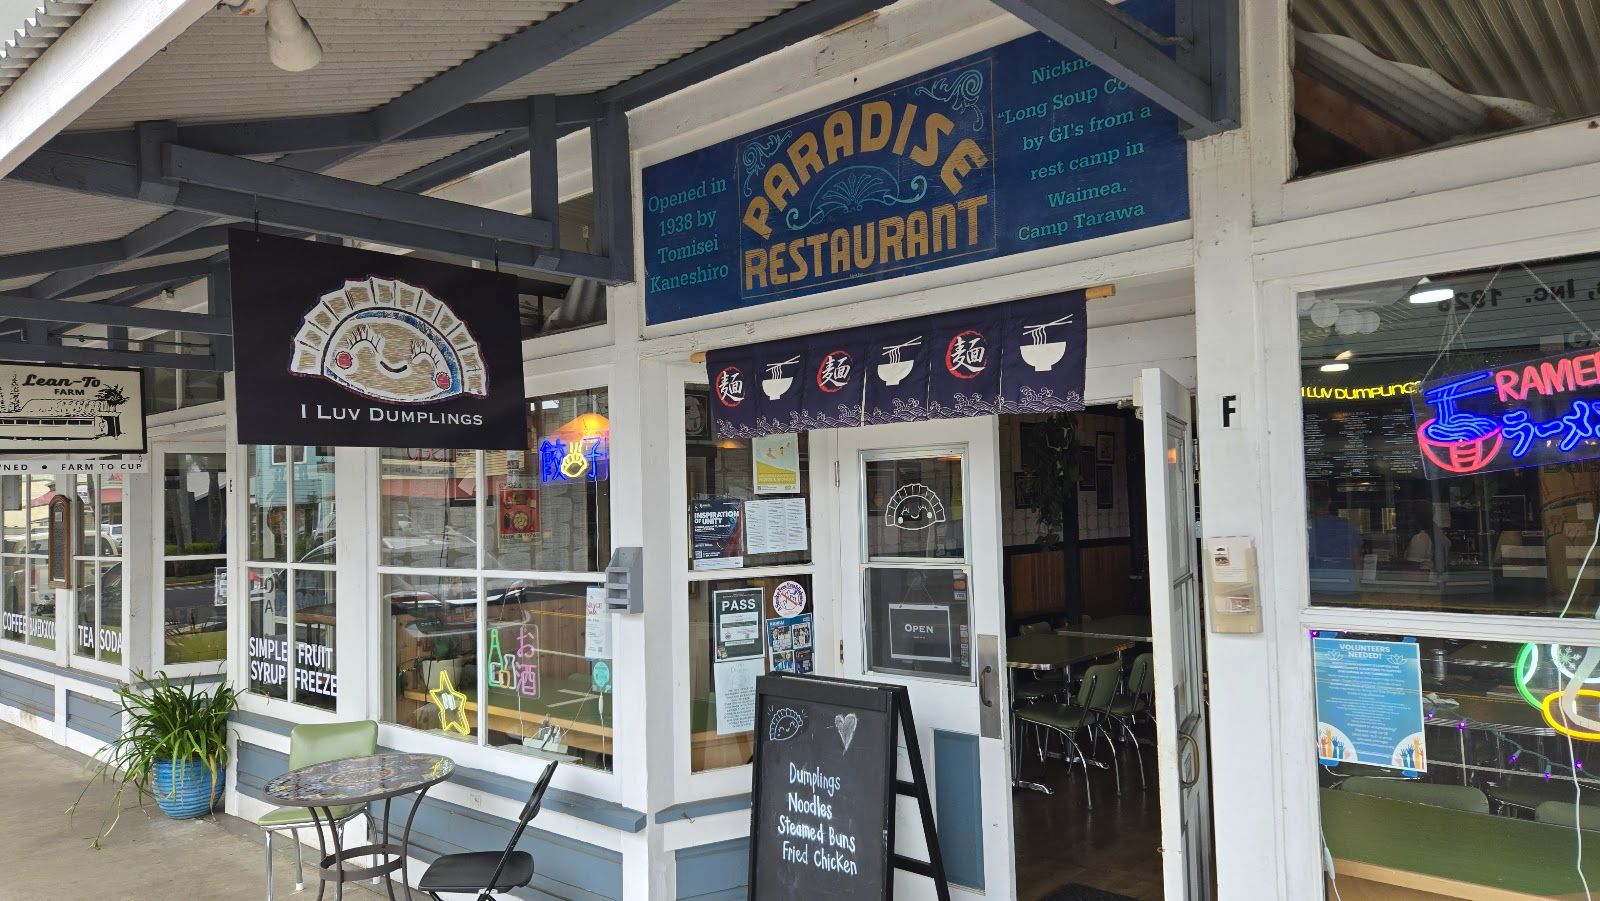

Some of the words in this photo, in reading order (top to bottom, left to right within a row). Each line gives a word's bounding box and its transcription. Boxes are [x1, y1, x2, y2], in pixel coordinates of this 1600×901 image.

[1031, 58, 1097, 85] Nickna
[1052, 87, 1098, 110] Soup
[1103, 77, 1132, 94] Co
[1022, 134, 1044, 151] by
[1088, 110, 1135, 132] from
[1140, 106, 1152, 118] a
[742, 100, 989, 240] PARADISE
[1030, 161, 1064, 181] rest
[1069, 147, 1120, 171] camp
[1125, 141, 1145, 157] in
[648, 182, 707, 213] Opened
[711, 178, 727, 195] in
[1047, 181, 1127, 208] Waimea.
[659, 213, 693, 237] 1938
[697, 210, 717, 228] by
[1018, 220, 1068, 241] Camp
[1073, 204, 1146, 229] Tarawa
[657, 234, 719, 265] Tomisei
[744, 194, 988, 290] RESTAURANT
[650, 264, 729, 293] Kaneshiro
[22, 374, 101, 388] Lean-To
[1495, 351, 1600, 402] RAME
[54, 388, 85, 396] FARM
[1306, 386, 1333, 399] LUV
[300, 404, 306, 419] I
[317, 404, 361, 422] LUV
[369, 406, 483, 426] DUMPLINGS
[1222, 395, 1237, 428] F
[0, 463, 28, 471] NED
[61, 463, 94, 471] FARM
[229, 479, 233, 493] E
[694, 510, 740, 519] INSPIRATION
[702, 517, 723, 525] UNITY
[721, 598, 756, 612] PASS
[78, 624, 95, 649] TEA
[99, 628, 122, 654] SODA
[904, 623, 934, 634] OPEN
[249, 636, 288, 662] SIMPLE
[298, 643, 334, 669] FRUIT
[516, 626, 536, 696] お酒
[1340, 643, 1391, 653] VOLUNTEERS
[1347, 651, 1382, 660] NEEDED!
[251, 661, 286, 685] SYRUP
[294, 668, 338, 697] FREEZE
[789, 762, 841, 797] Dumplings
[788, 792, 833, 820] Noodles
[777, 815, 824, 844] Steamed
[829, 828, 856, 854] Buns
[782, 840, 808, 865] Fried
